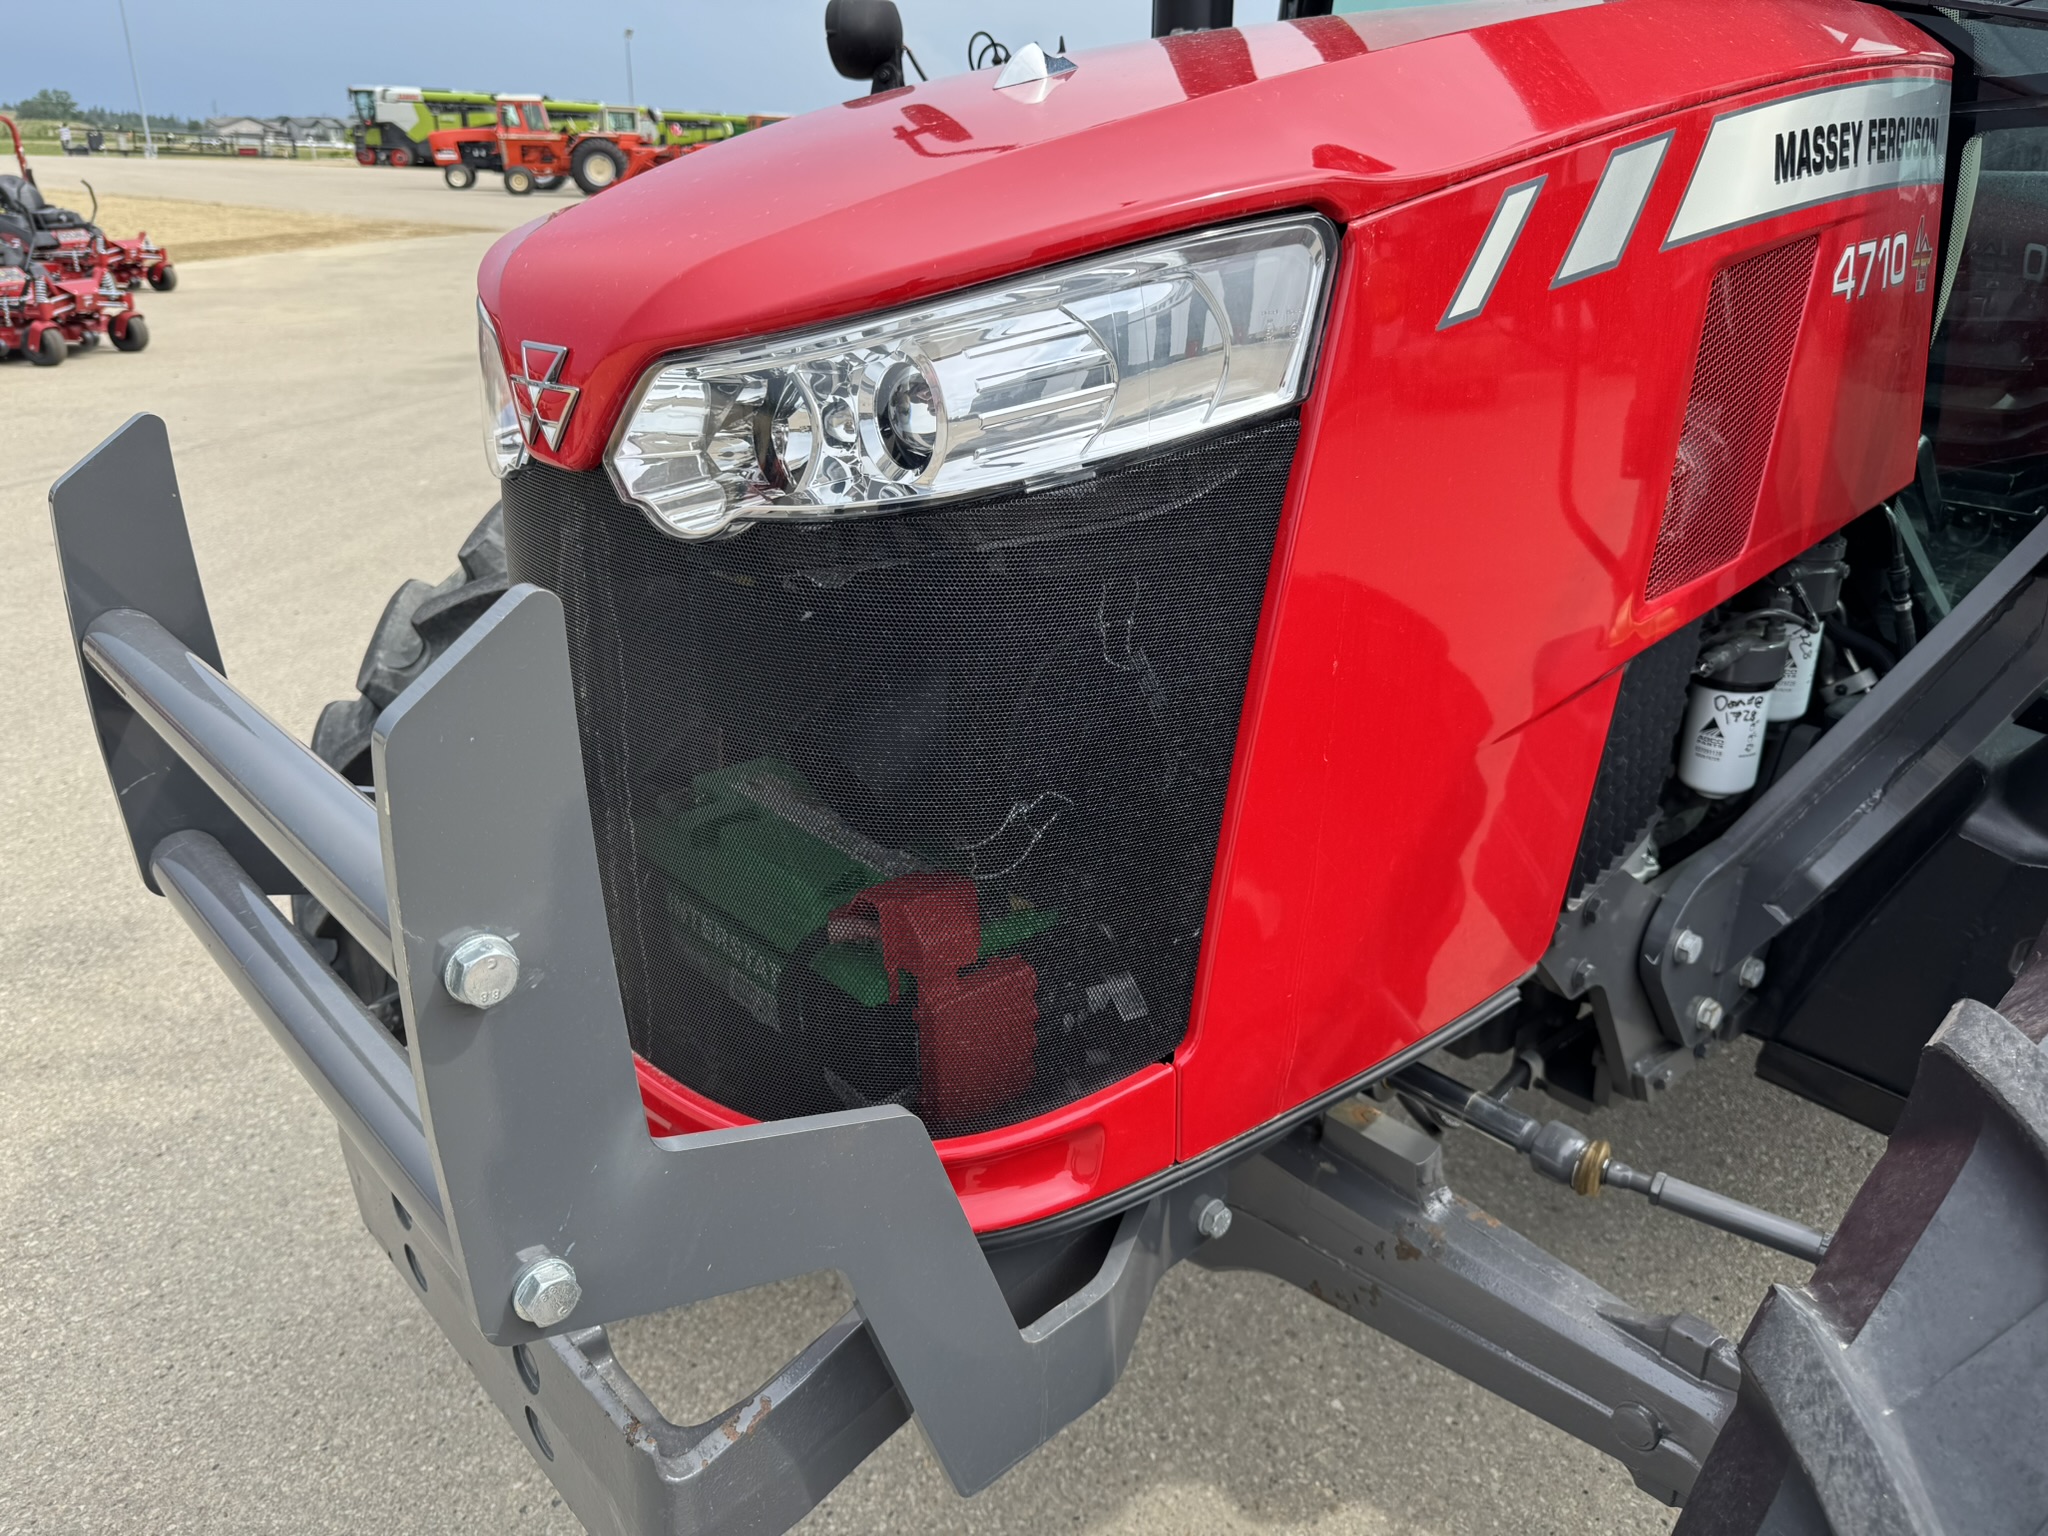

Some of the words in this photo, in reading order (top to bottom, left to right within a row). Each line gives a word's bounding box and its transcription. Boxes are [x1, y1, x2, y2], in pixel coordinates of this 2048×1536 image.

[1774, 120, 1863, 184] MASSEY
[1867, 116, 1939, 164] FERGUSON
[1832, 231, 1908, 302] 4710
